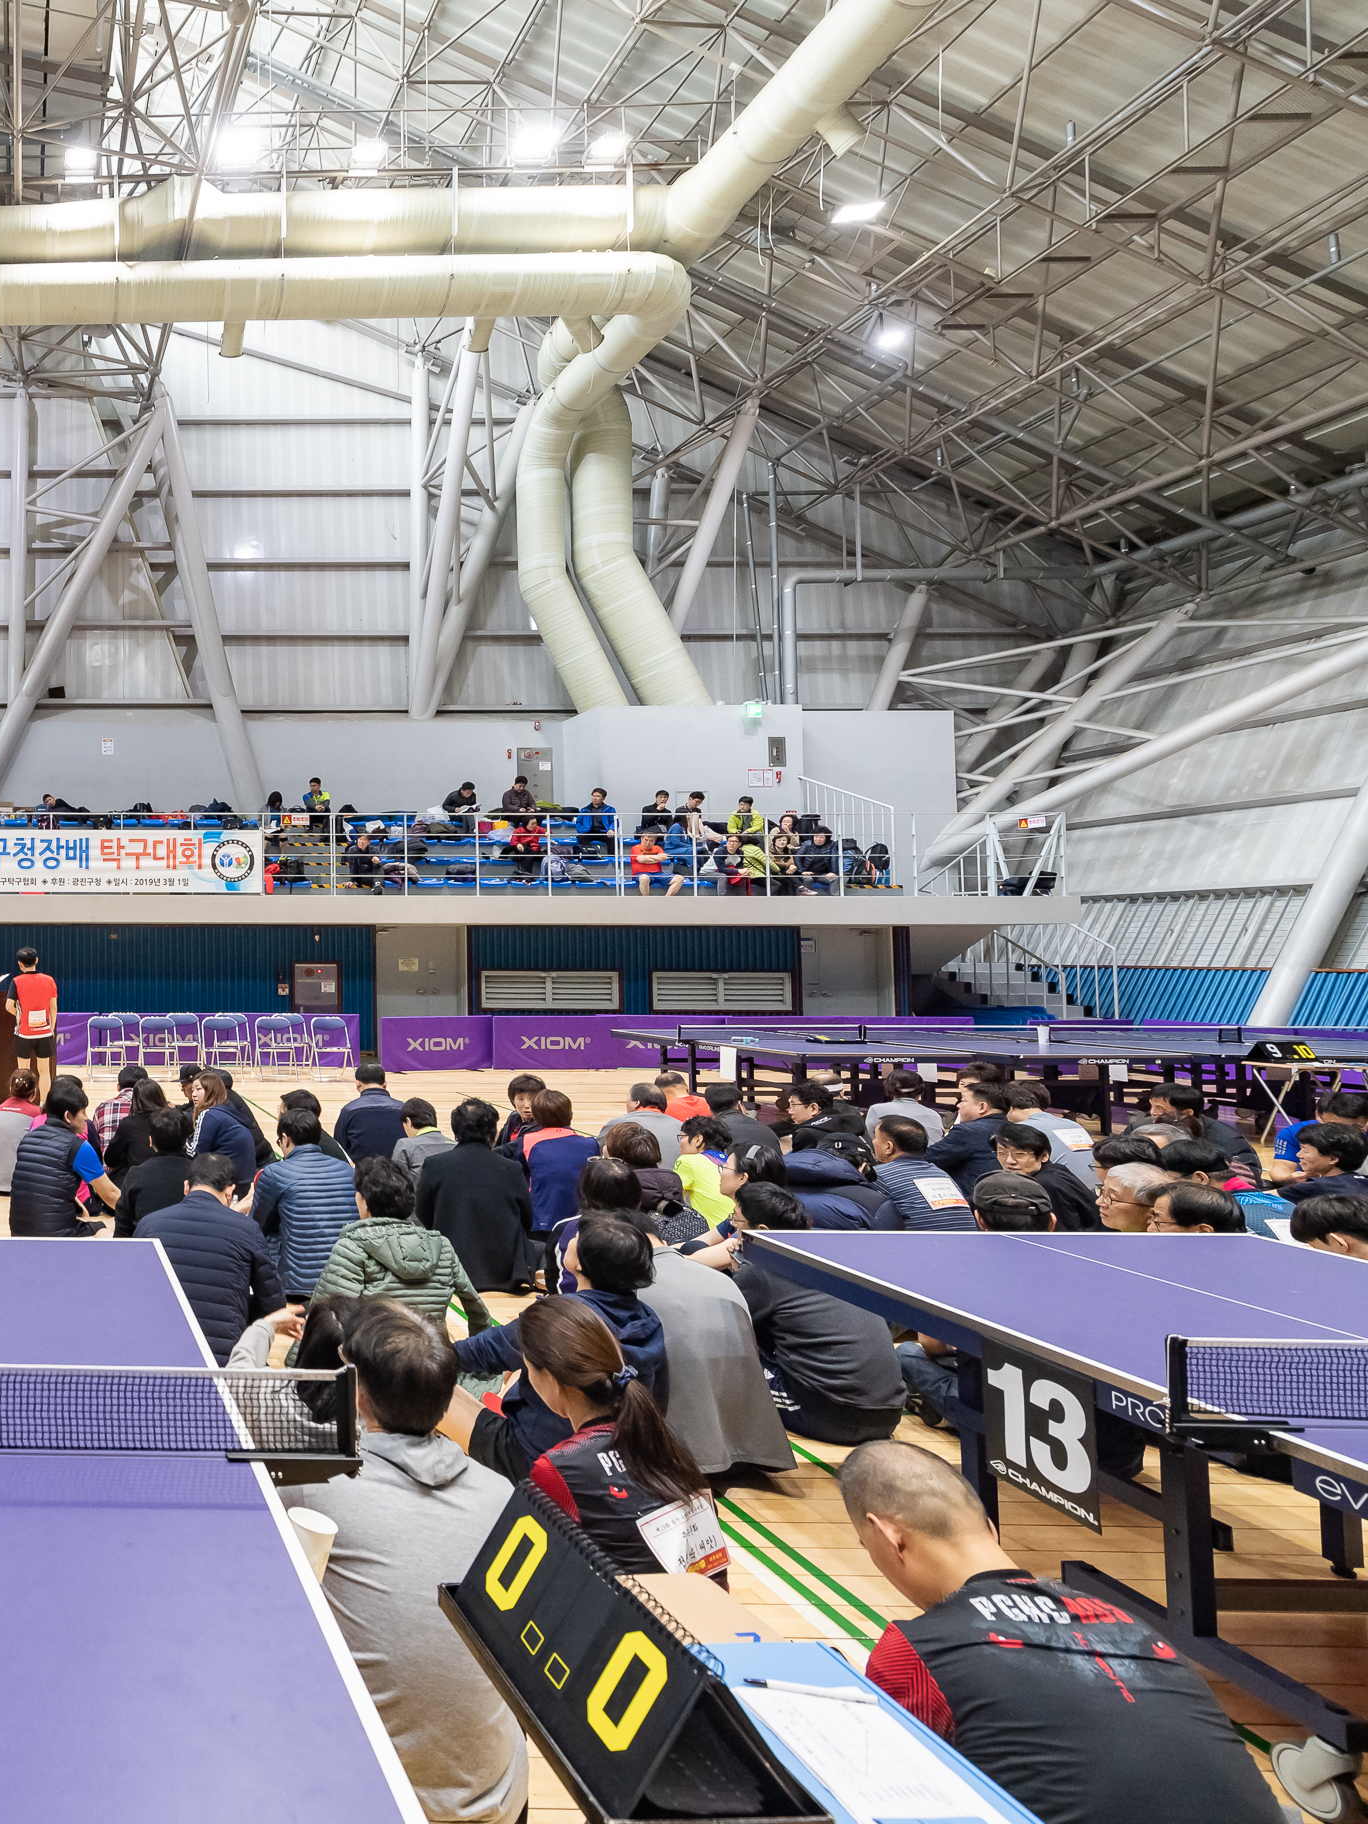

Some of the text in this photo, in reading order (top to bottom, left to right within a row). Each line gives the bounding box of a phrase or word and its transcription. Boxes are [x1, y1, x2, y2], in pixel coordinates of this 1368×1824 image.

[100, 837, 203, 870] 탁구대회
[50, 876, 66, 887] 후원
[71, 876, 102, 887] 광진구청
[113, 876, 128, 887] 일시
[134, 876, 161, 887] 2019년
[162, 876, 175, 887] 3월
[177, 876, 189, 886] 1일
[406, 1037, 464, 1051] XIOM
[520, 1036, 585, 1050] XIOM
[1265, 1044, 1316, 1059] 9 10
[987, 1362, 1092, 1494] 13
[1008, 1469, 1098, 1525] CHAMPION
[485, 1514, 669, 1752] 0 0
